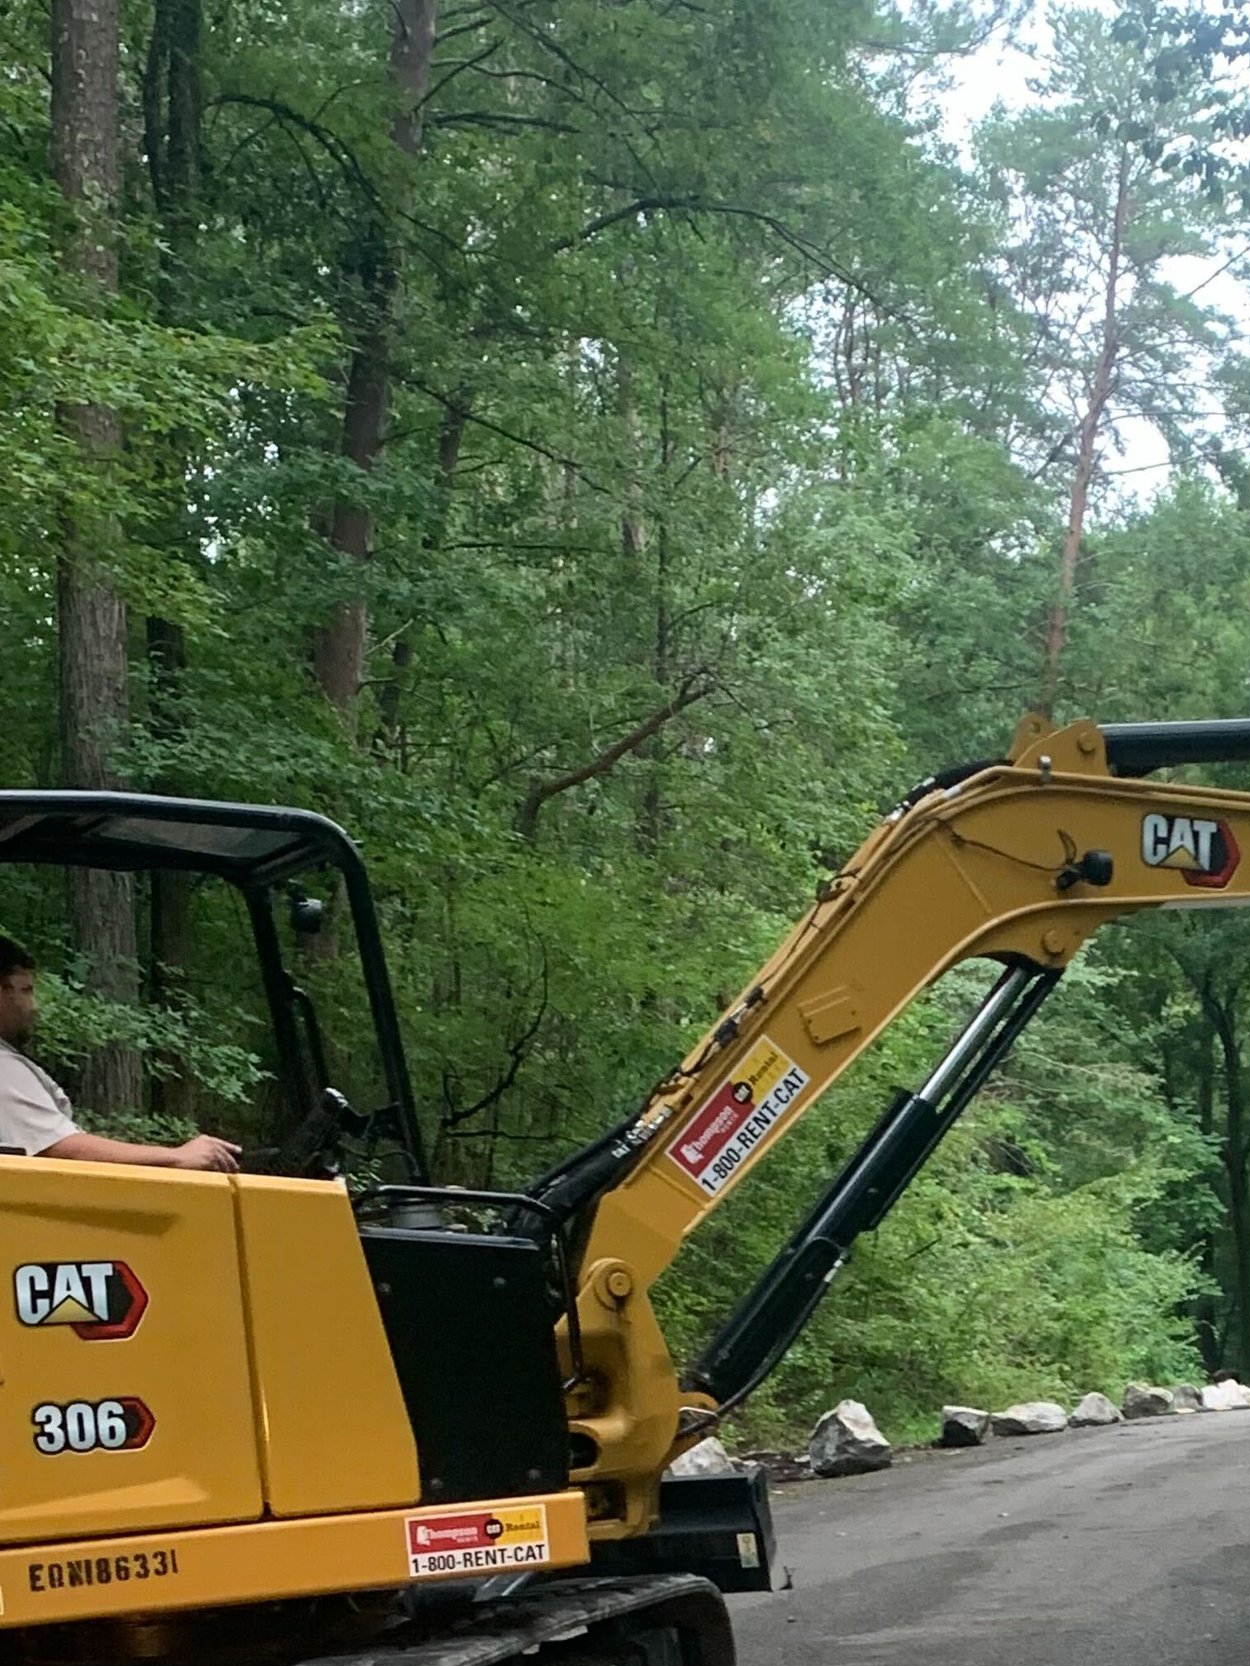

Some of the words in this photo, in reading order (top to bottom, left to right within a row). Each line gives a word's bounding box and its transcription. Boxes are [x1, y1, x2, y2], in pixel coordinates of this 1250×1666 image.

[1142, 813, 1217, 871] CAT
[701, 1067, 805, 1191] 1-800-RENT-CAT
[15, 1263, 114, 1325] CAT
[34, 1400, 127, 1453] 306
[412, 1544, 546, 1574] 1-800-RENT-CAT
